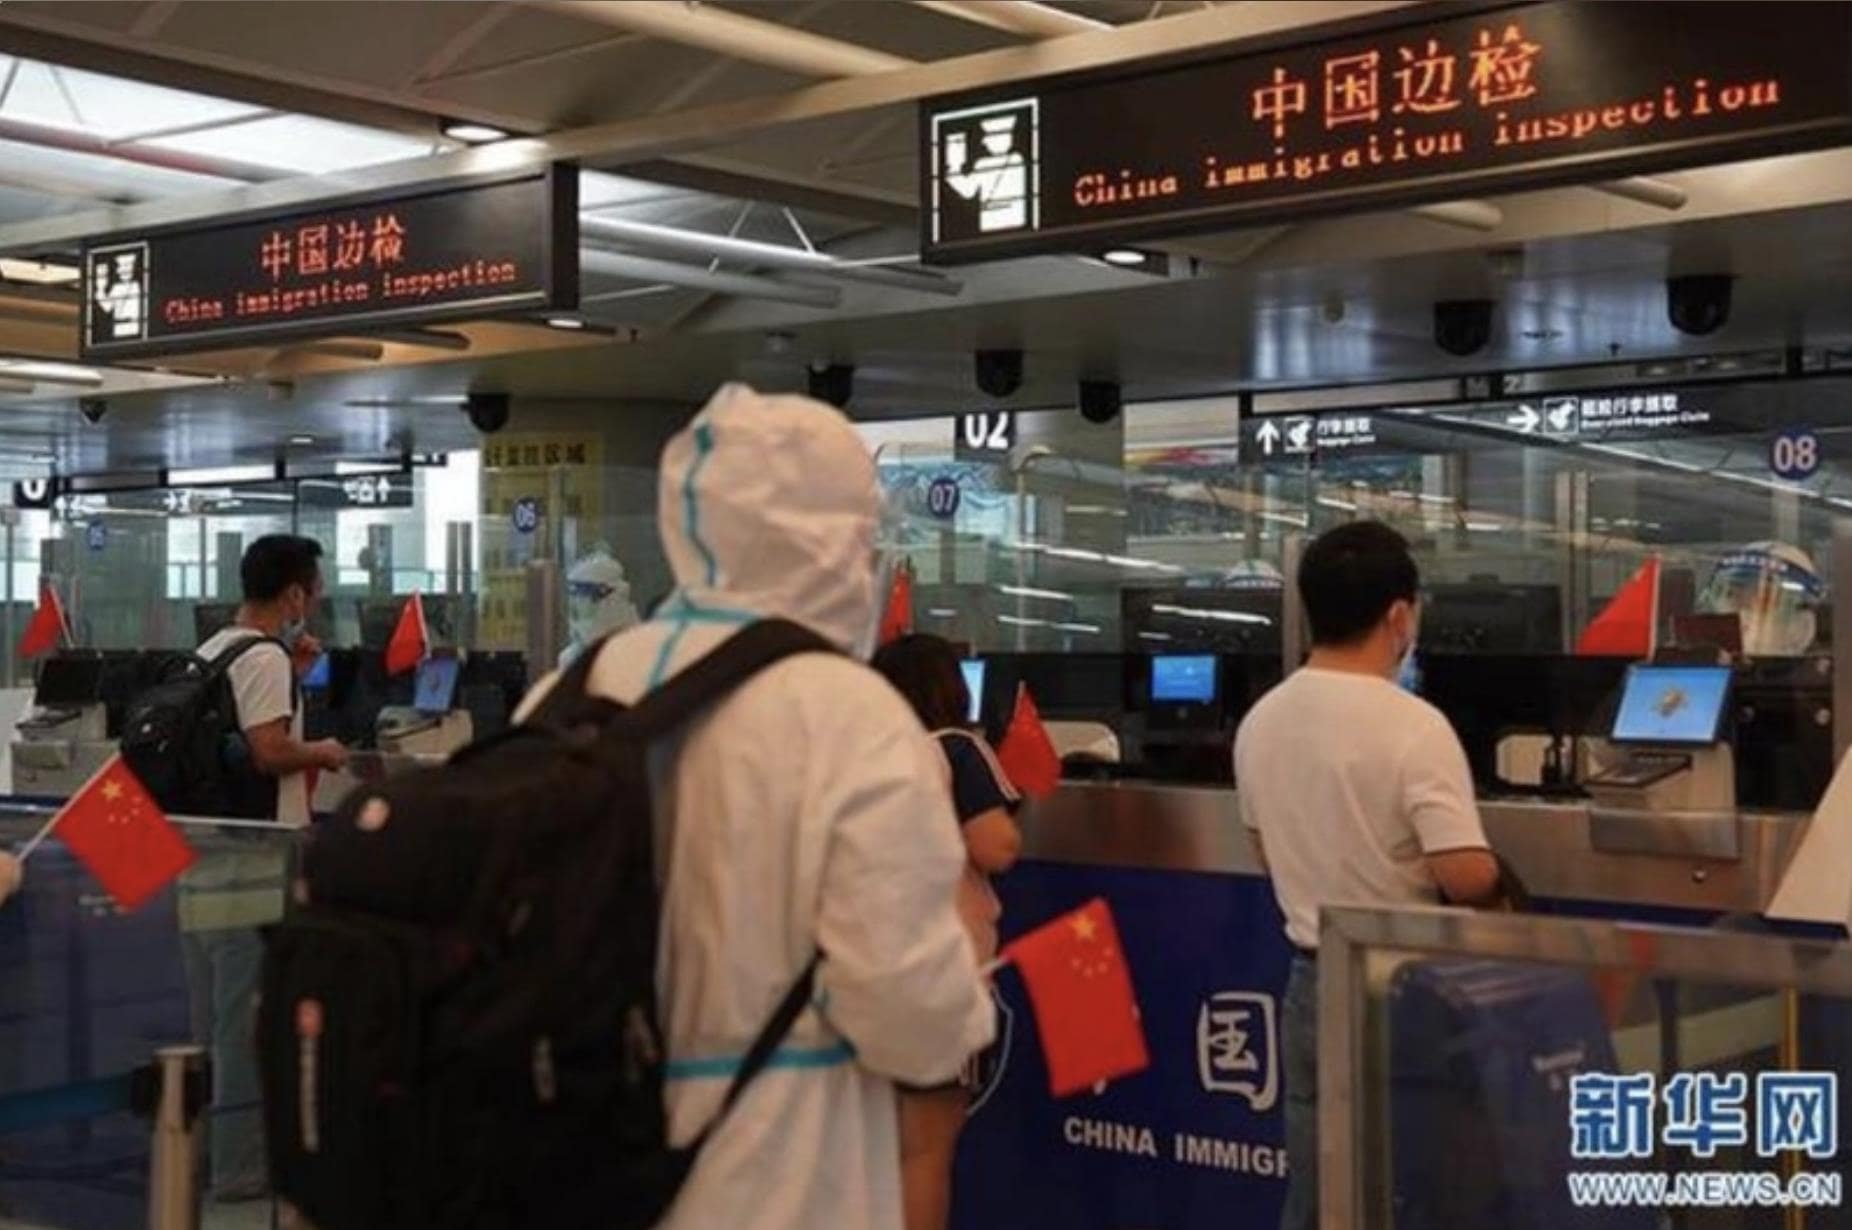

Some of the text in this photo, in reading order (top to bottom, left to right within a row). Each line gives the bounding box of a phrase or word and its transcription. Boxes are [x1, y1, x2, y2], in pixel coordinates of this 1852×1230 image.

[1252, 26, 1542, 139] 中国边检
[1075, 79, 1780, 206] China immigration inspection
[261, 213, 406, 281] 中国边检
[165, 261, 516, 323] China immigration inspection
[965, 411, 1008, 449] 02
[1774, 435, 1817, 473] 08
[931, 484, 955, 513] 07
[1063, 1116, 1158, 1158] CHINA
